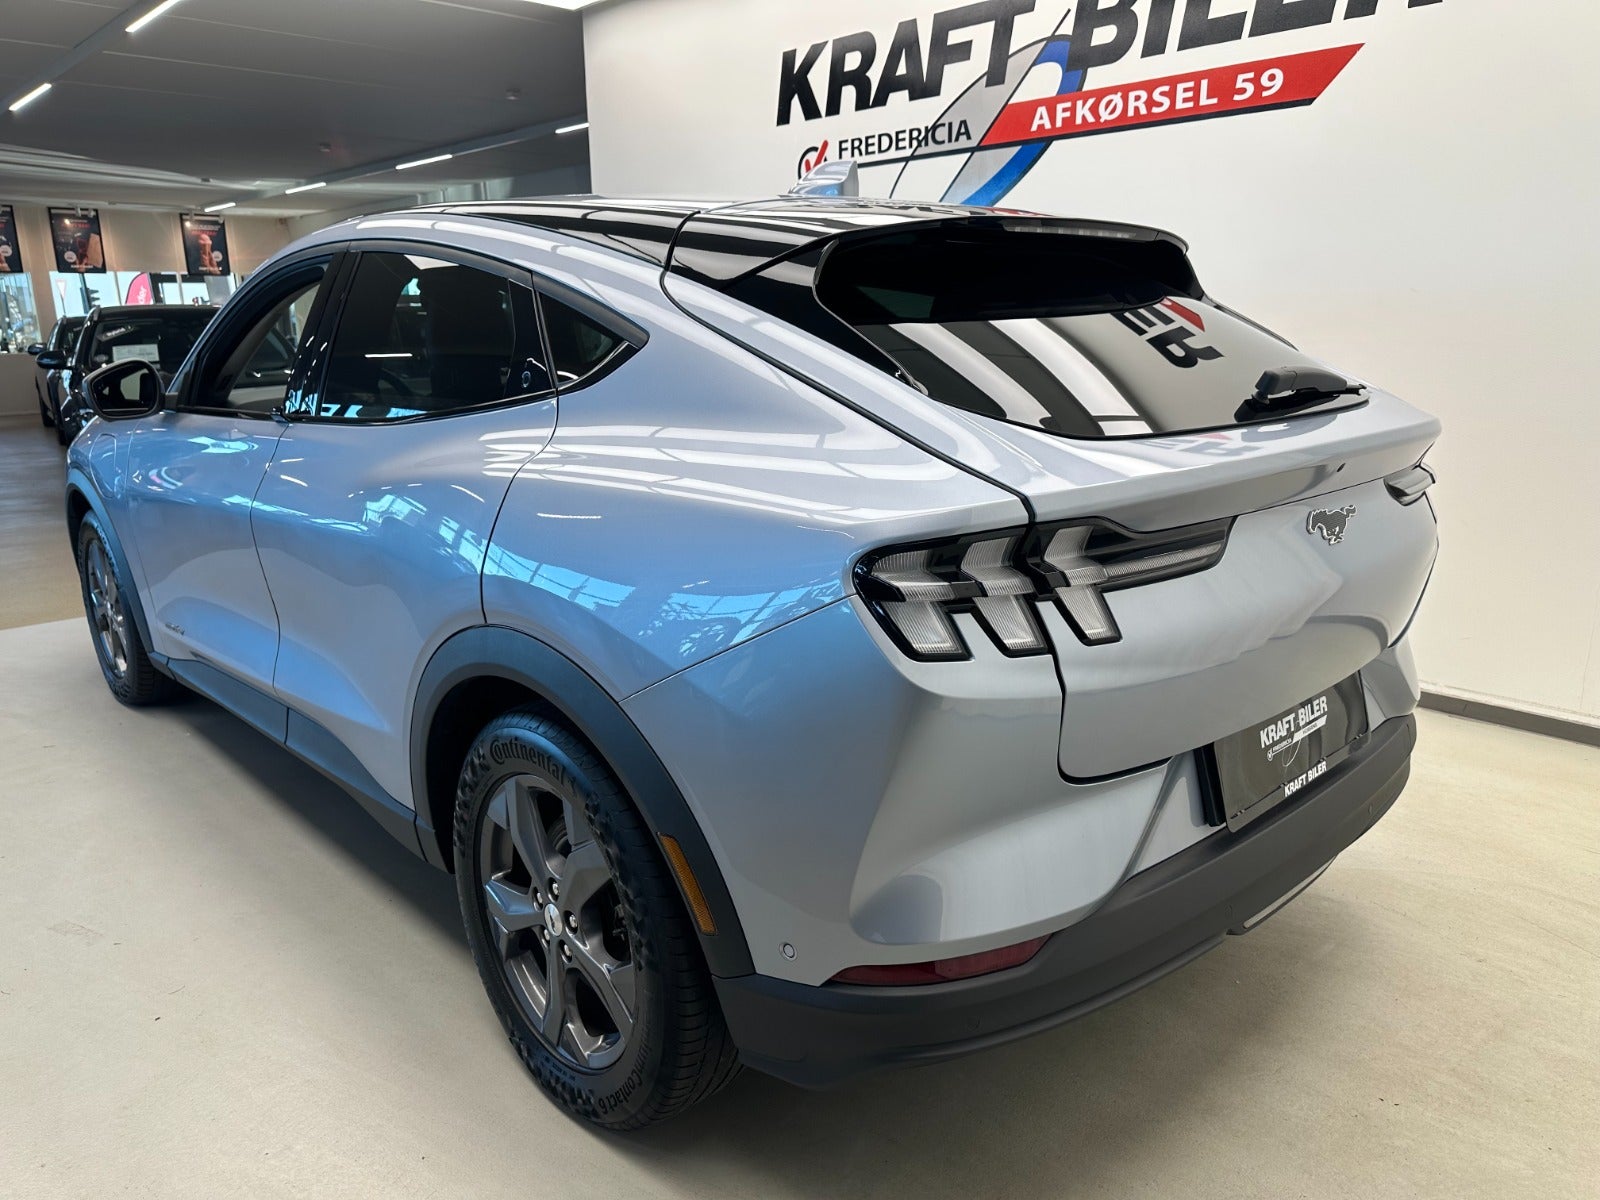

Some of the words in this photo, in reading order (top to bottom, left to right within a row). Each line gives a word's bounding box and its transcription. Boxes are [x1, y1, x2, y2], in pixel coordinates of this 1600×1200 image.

[776, 0, 1036, 126] KRAFT
[1066, 0, 1443, 70] BIL
[1030, 79, 1218, 133] AFKØRSEL
[1233, 69, 1284, 99] 59
[838, 119, 972, 160] FREDERICIA
[1260, 712, 1297, 748] KRAFT
[1298, 696, 1328, 727] BILER
[490, 736, 566, 785] Continental
[1284, 773, 1307, 797] KRAFT
[1307, 761, 1327, 783] BILER
